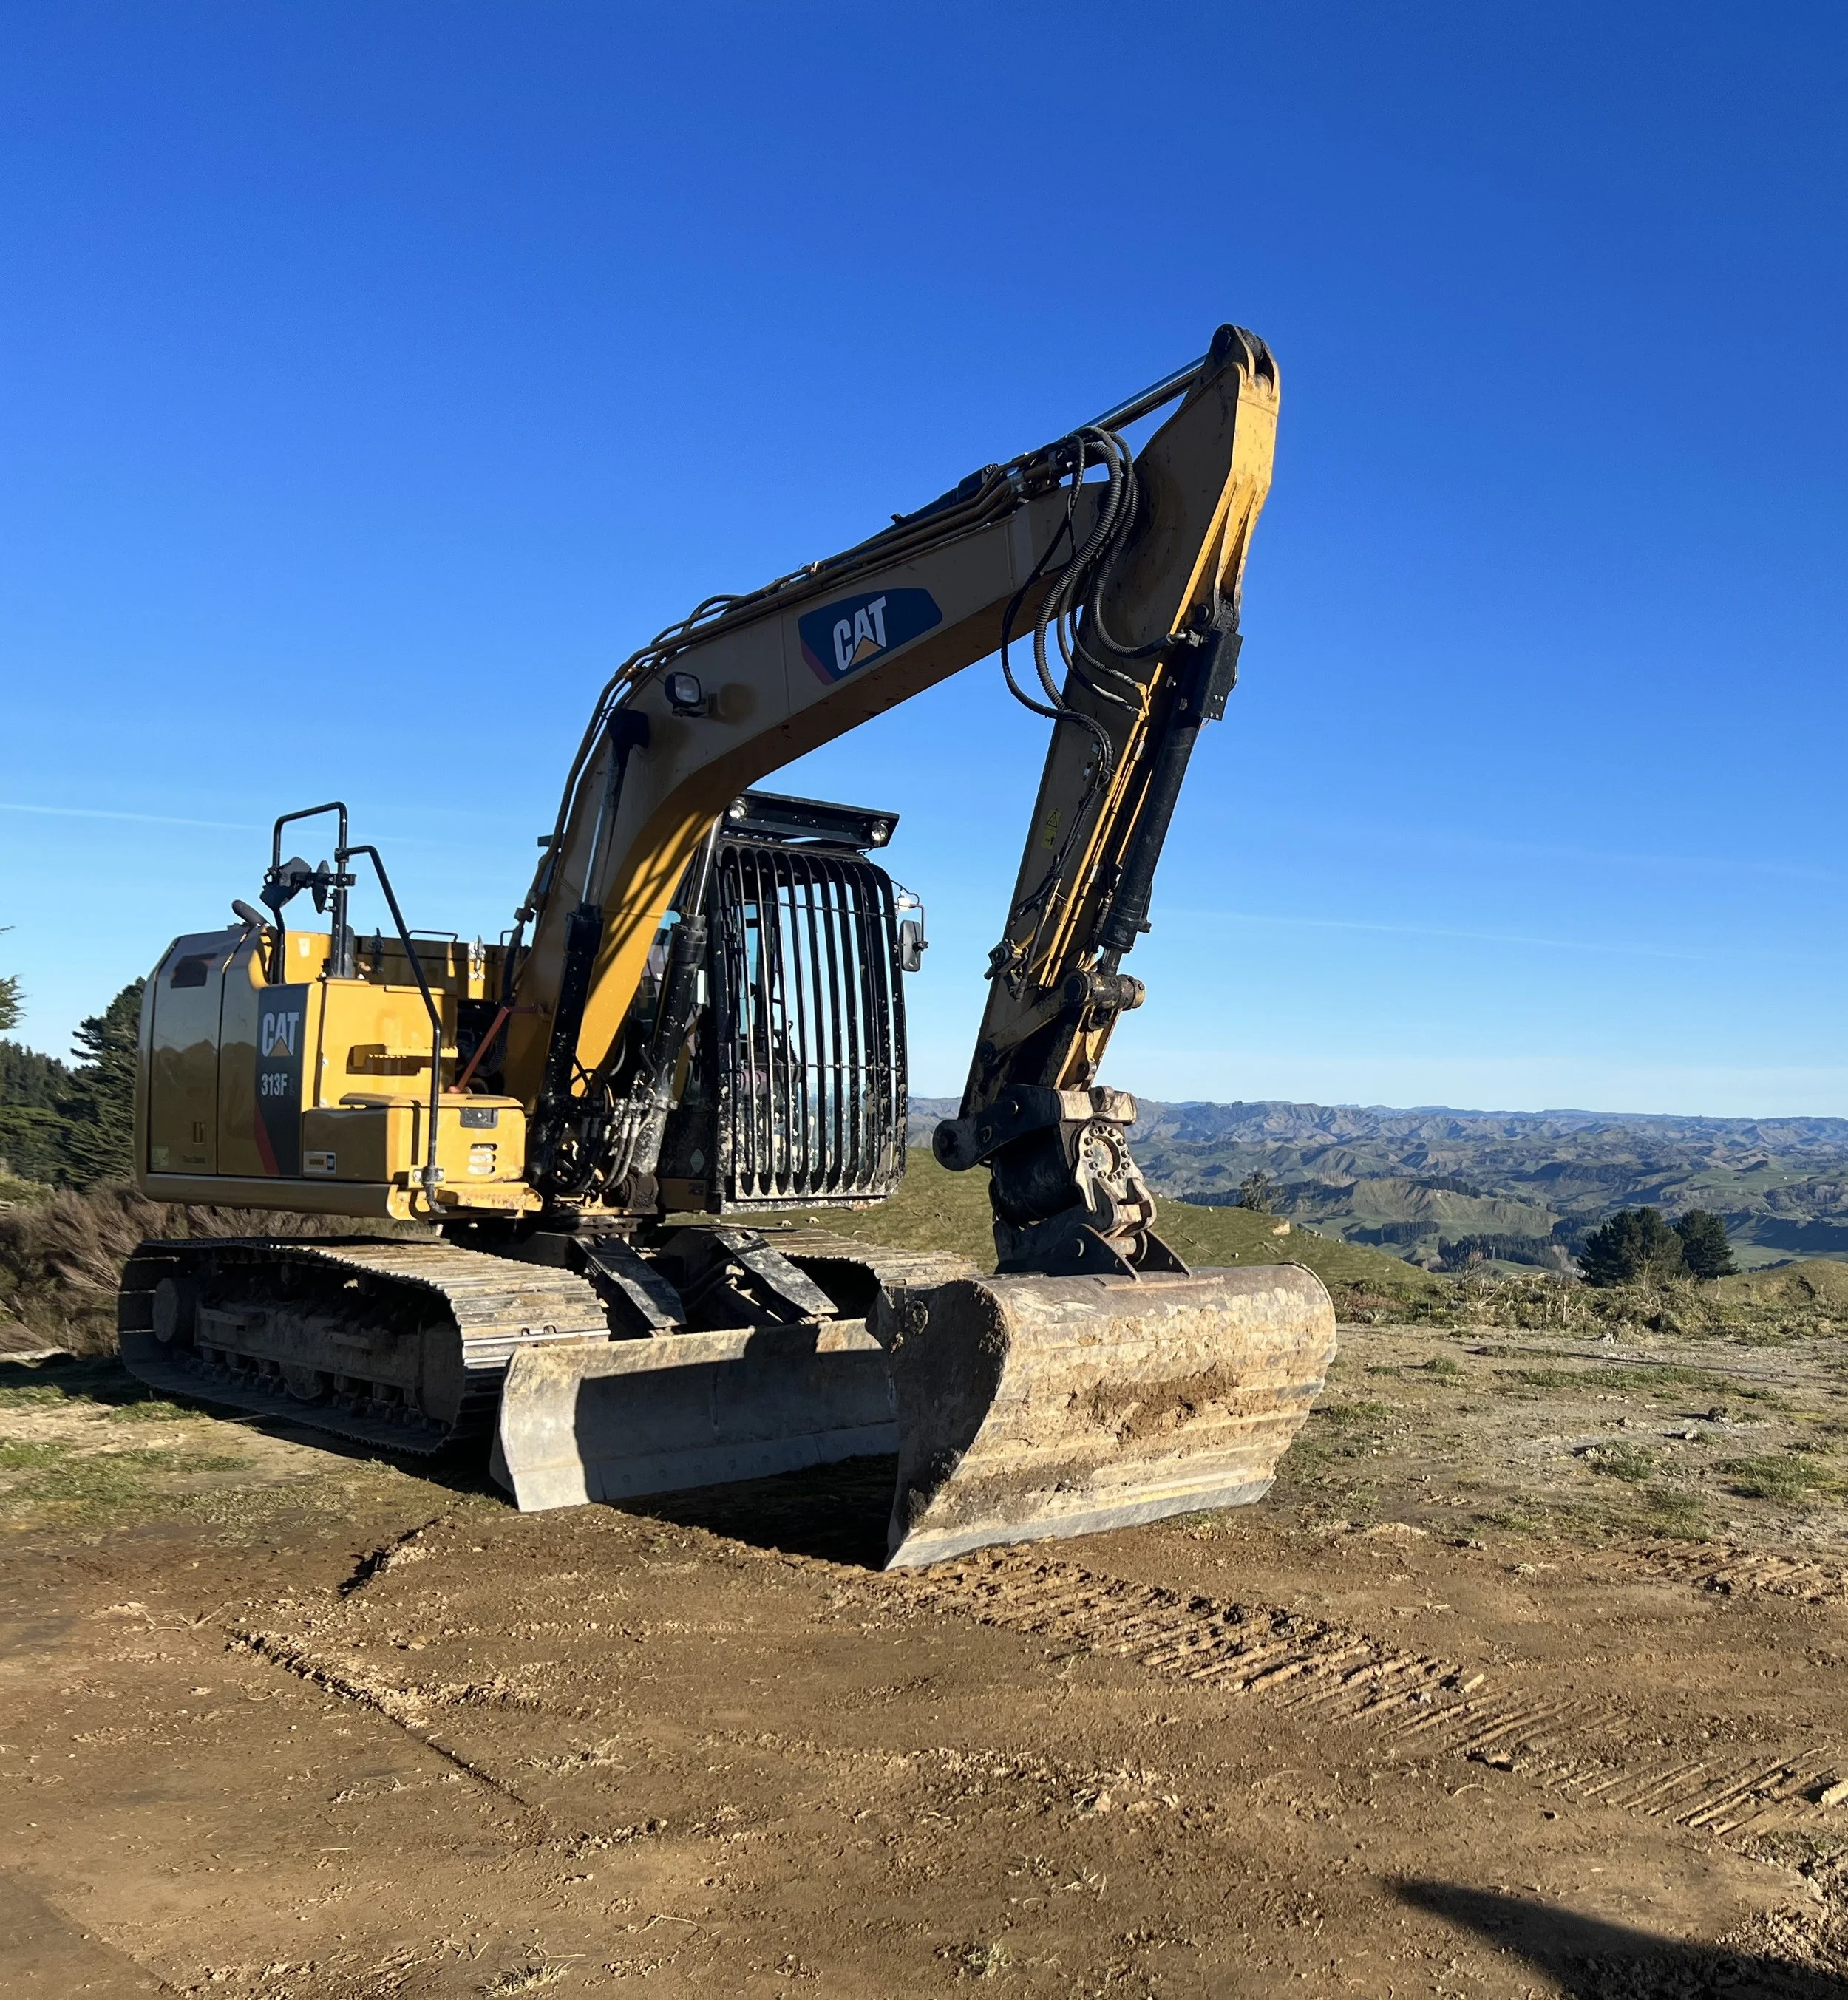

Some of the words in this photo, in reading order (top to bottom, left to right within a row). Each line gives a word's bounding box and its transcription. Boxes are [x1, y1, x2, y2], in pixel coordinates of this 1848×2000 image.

[833, 596, 887, 670] CAT
[262, 1012, 299, 1057] CAT
[261, 1073, 288, 1096] 313F
